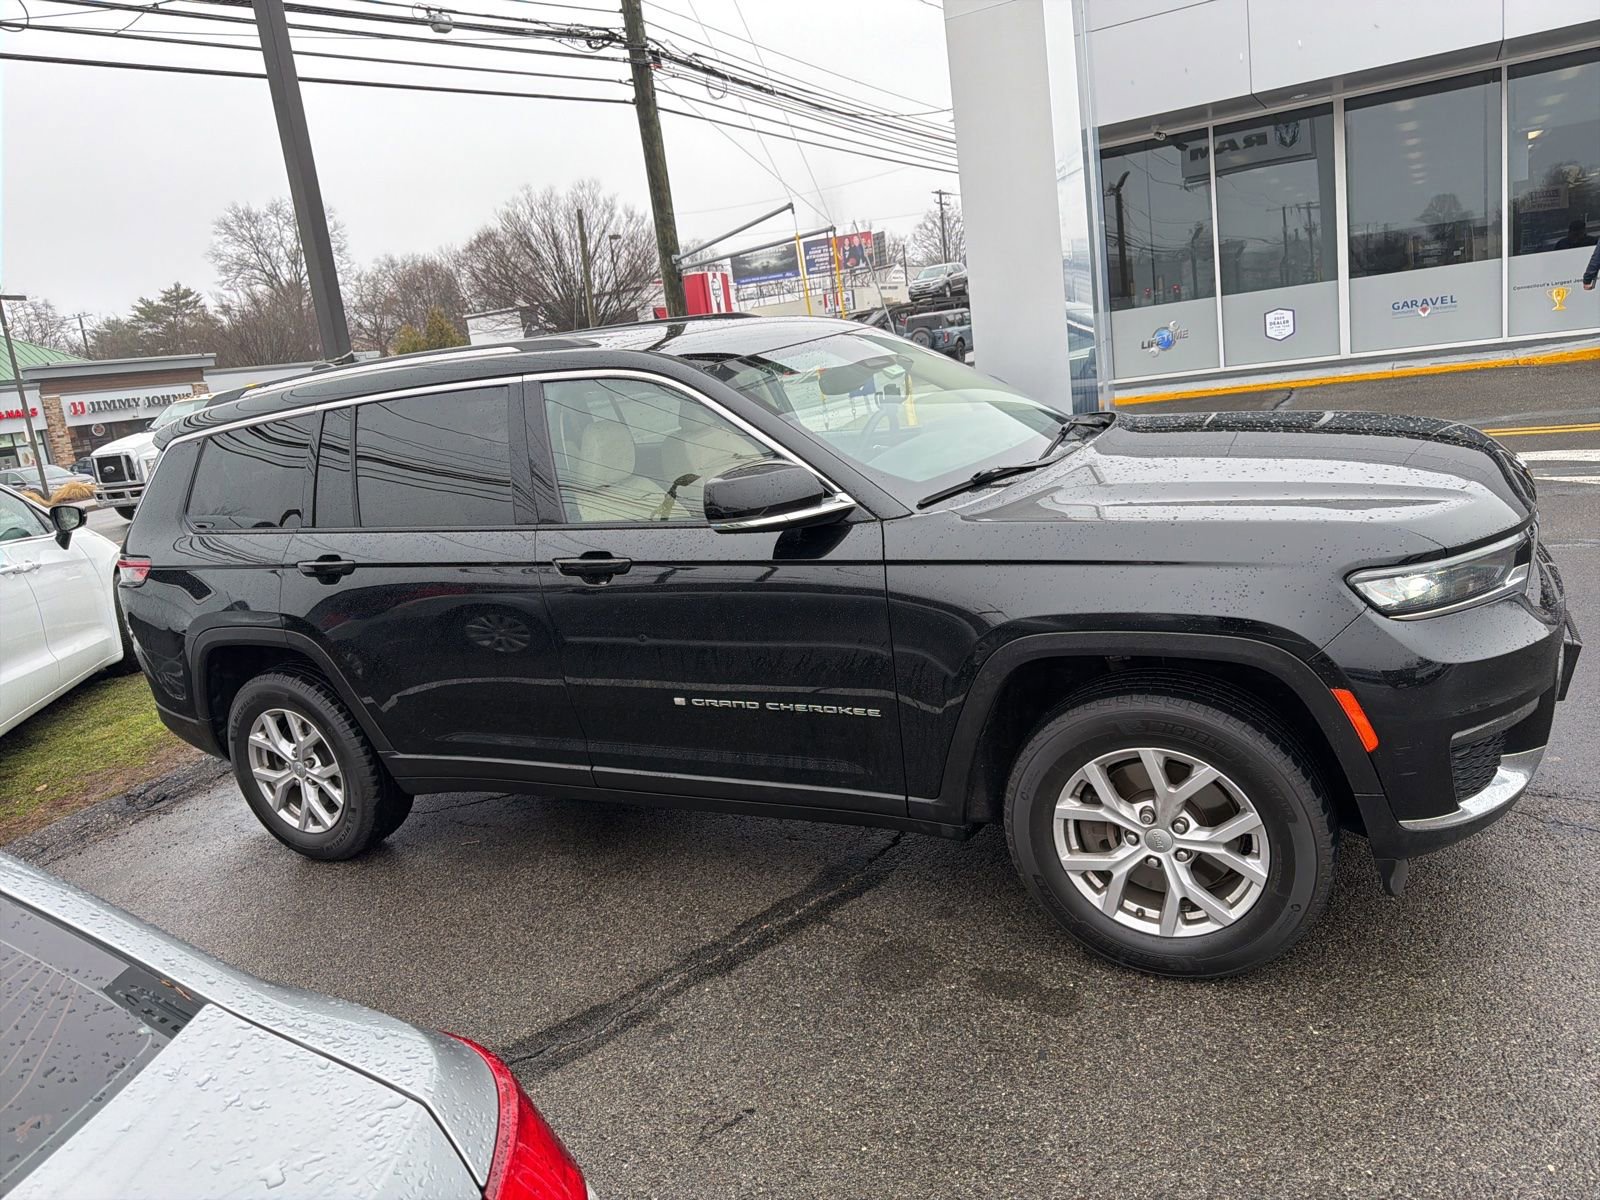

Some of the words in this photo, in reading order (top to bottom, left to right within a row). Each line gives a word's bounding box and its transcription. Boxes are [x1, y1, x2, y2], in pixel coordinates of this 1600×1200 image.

[1551, 279, 1573, 287] Largest
[1391, 294, 1458, 311] GARAVEL
[1269, 319, 1290, 327] DEALER
[70, 401, 86, 416] JJ
[89, 397, 140, 413] JIMMY
[691, 698, 760, 710] GRAND
[765, 702, 882, 717] CHEROKEE
